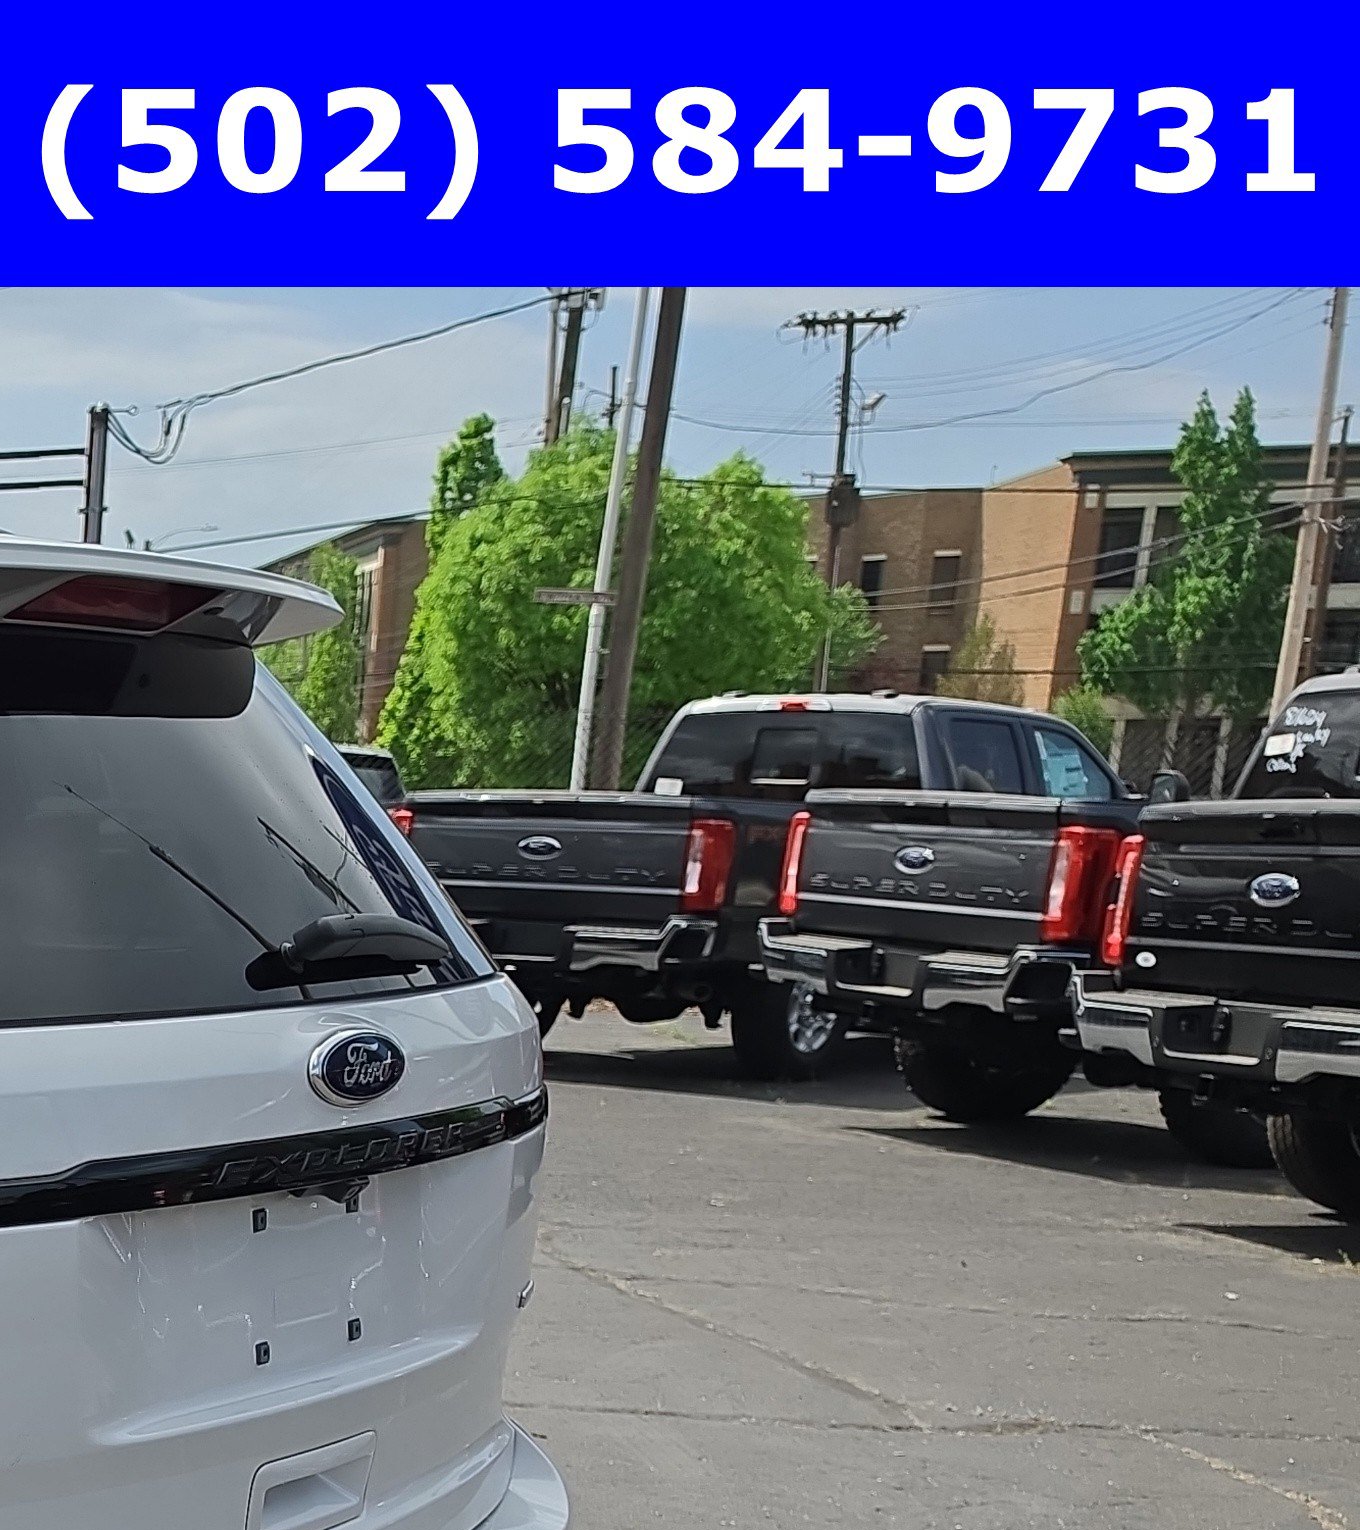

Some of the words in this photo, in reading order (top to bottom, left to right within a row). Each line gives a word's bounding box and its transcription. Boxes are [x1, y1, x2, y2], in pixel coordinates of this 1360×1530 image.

[557, 865, 667, 882] DUTY
[807, 872, 920, 896] SUPER
[928, 881, 1030, 904] DUTY
[1140, 911, 1279, 936] SUPER
[210, 1121, 467, 1187] EXPLORER
